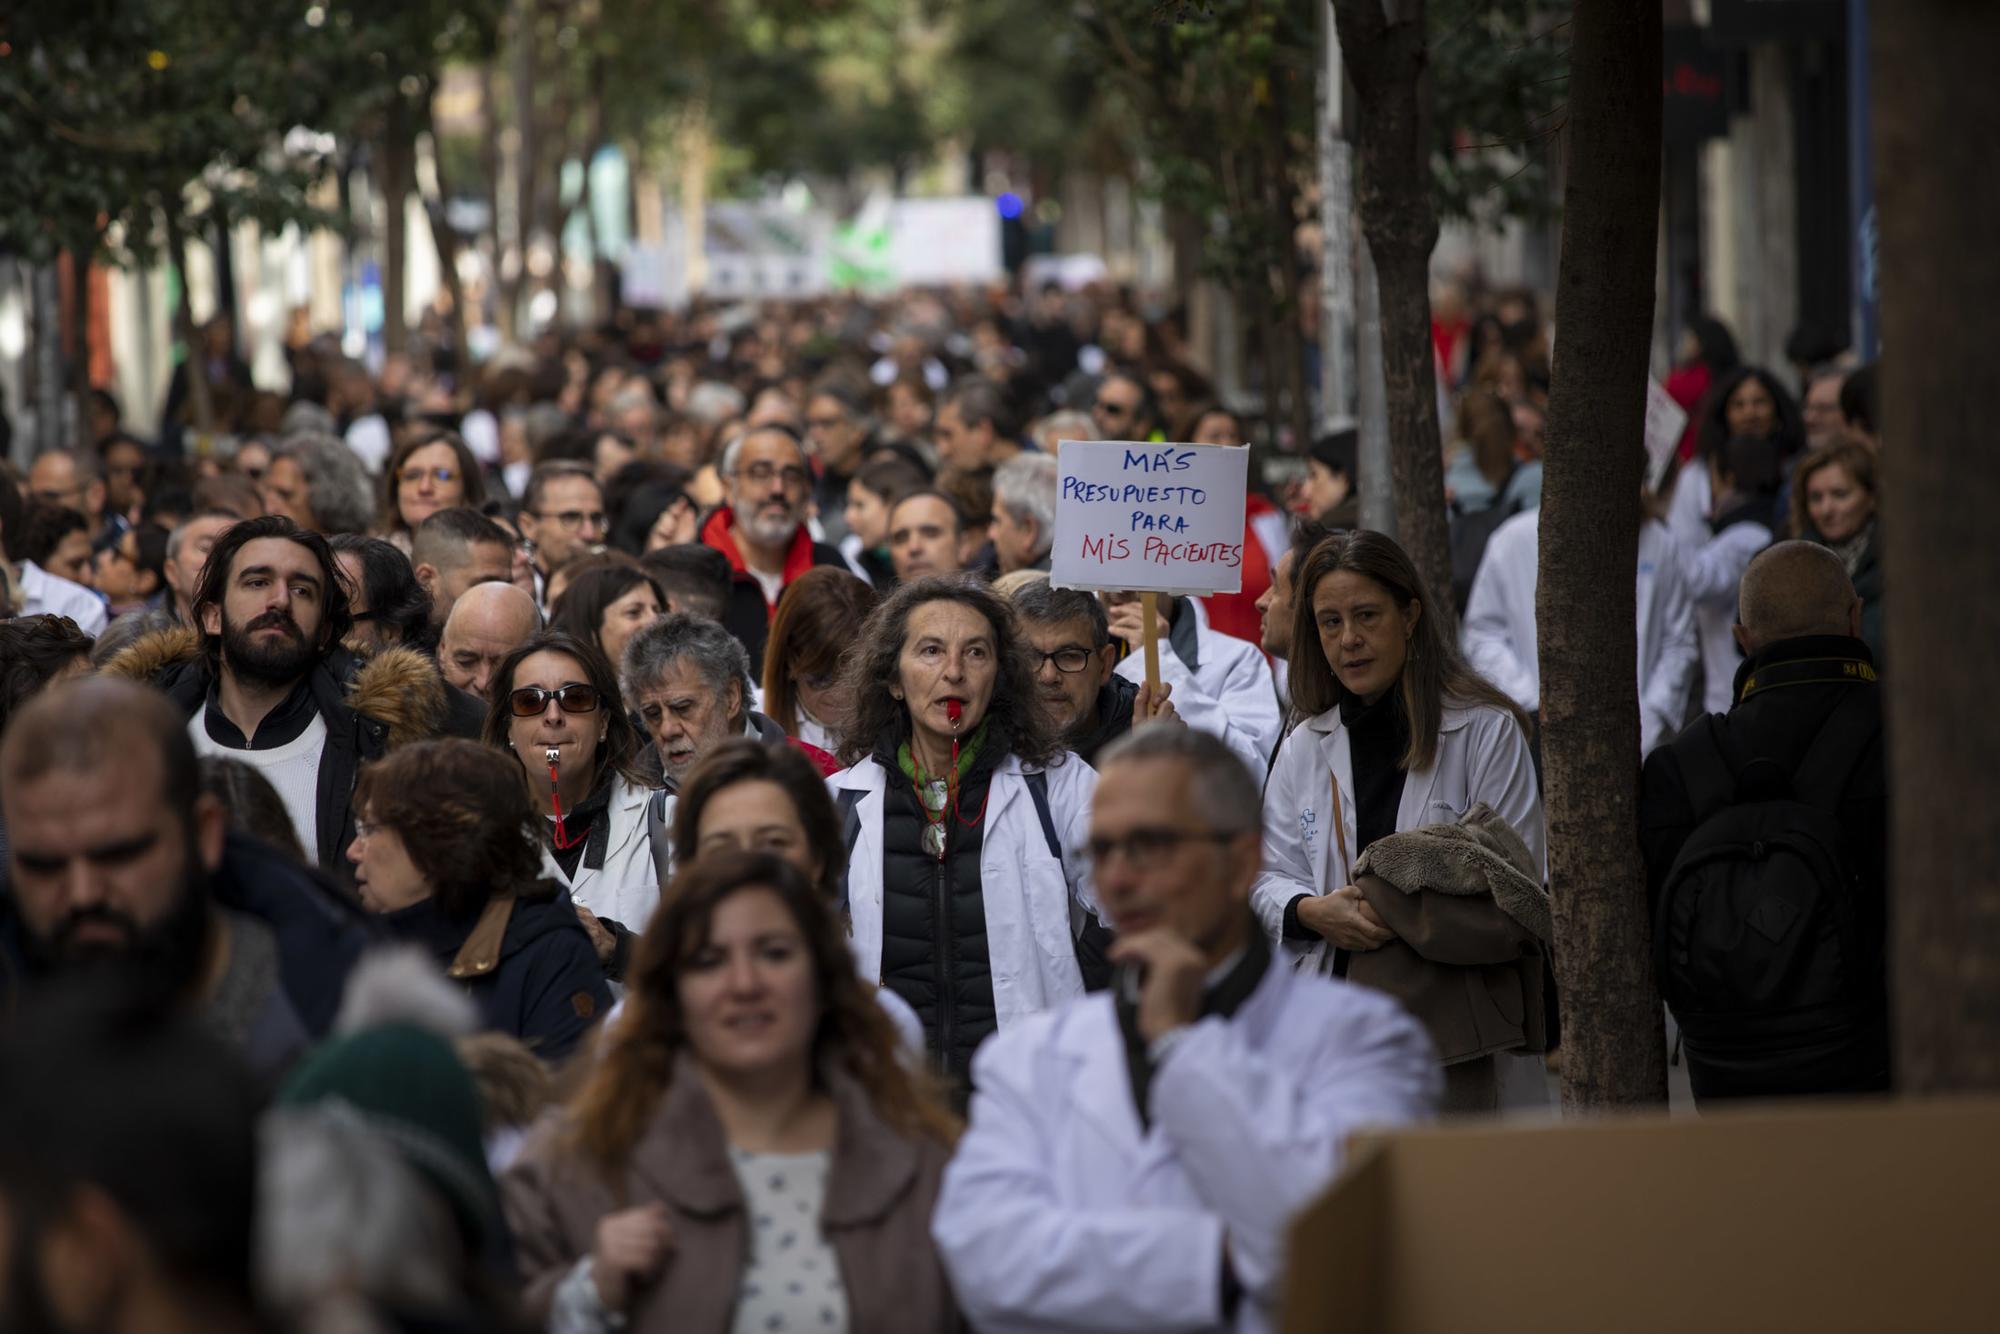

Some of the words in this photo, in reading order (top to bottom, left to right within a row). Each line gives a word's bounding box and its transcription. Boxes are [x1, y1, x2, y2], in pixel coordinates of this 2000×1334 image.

[1123, 448, 1197, 473] MÁS
[1063, 476, 1207, 505] PRESUPUESTO
[1131, 511, 1190, 534] PARA
